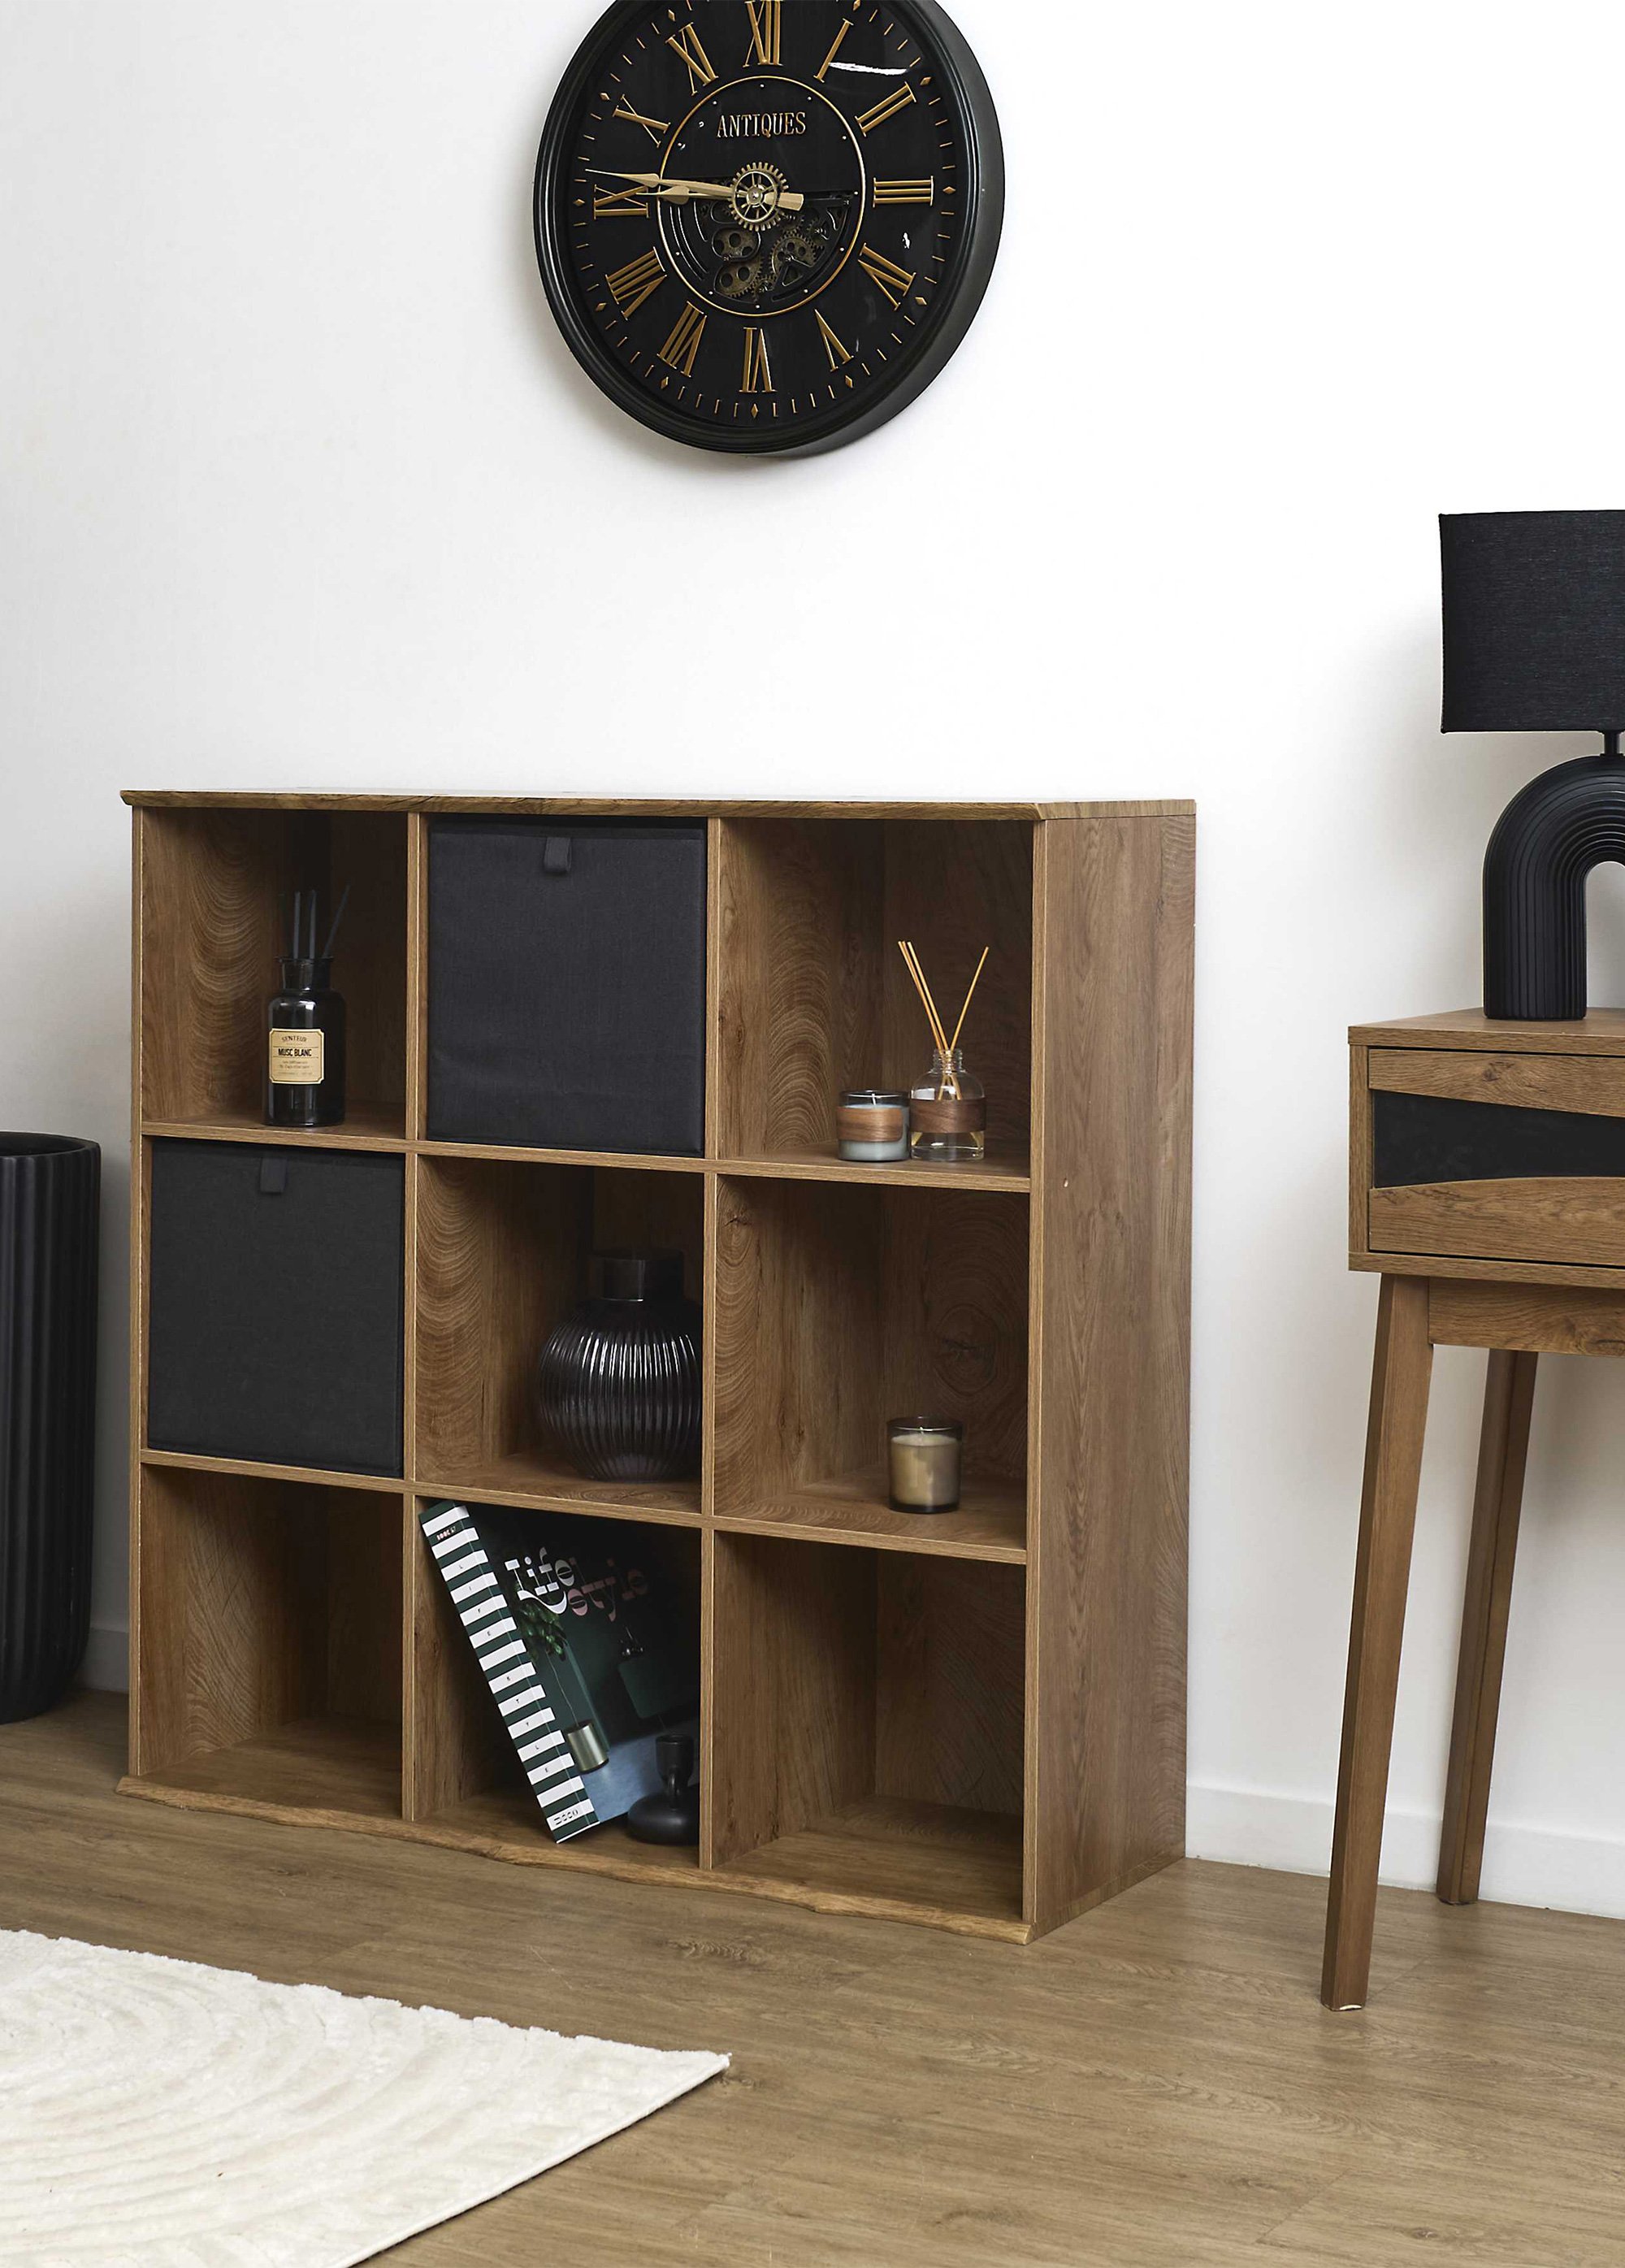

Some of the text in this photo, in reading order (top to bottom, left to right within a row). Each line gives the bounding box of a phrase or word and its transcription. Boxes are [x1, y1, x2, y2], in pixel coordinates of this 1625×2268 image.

[665, 22, 719, 96] XI
[743, 0, 783, 67] XII
[613, 94, 671, 148] X
[717, 112, 806, 138] ANTIQUES
[855, 81, 916, 137] II
[593, 184, 650, 219] IX
[873, 176, 934, 208] III
[605, 246, 668, 320] VIII
[858, 242, 916, 311] IV
[656, 301, 707, 378] VII
[739, 327, 778, 392] VI
[814, 309, 854, 372] V
[278, 1048, 312, 1056] MUSC BLANC
[505, 1546, 574, 1614] Life
[458, 1564, 549, 1773] LIFE STYLE
